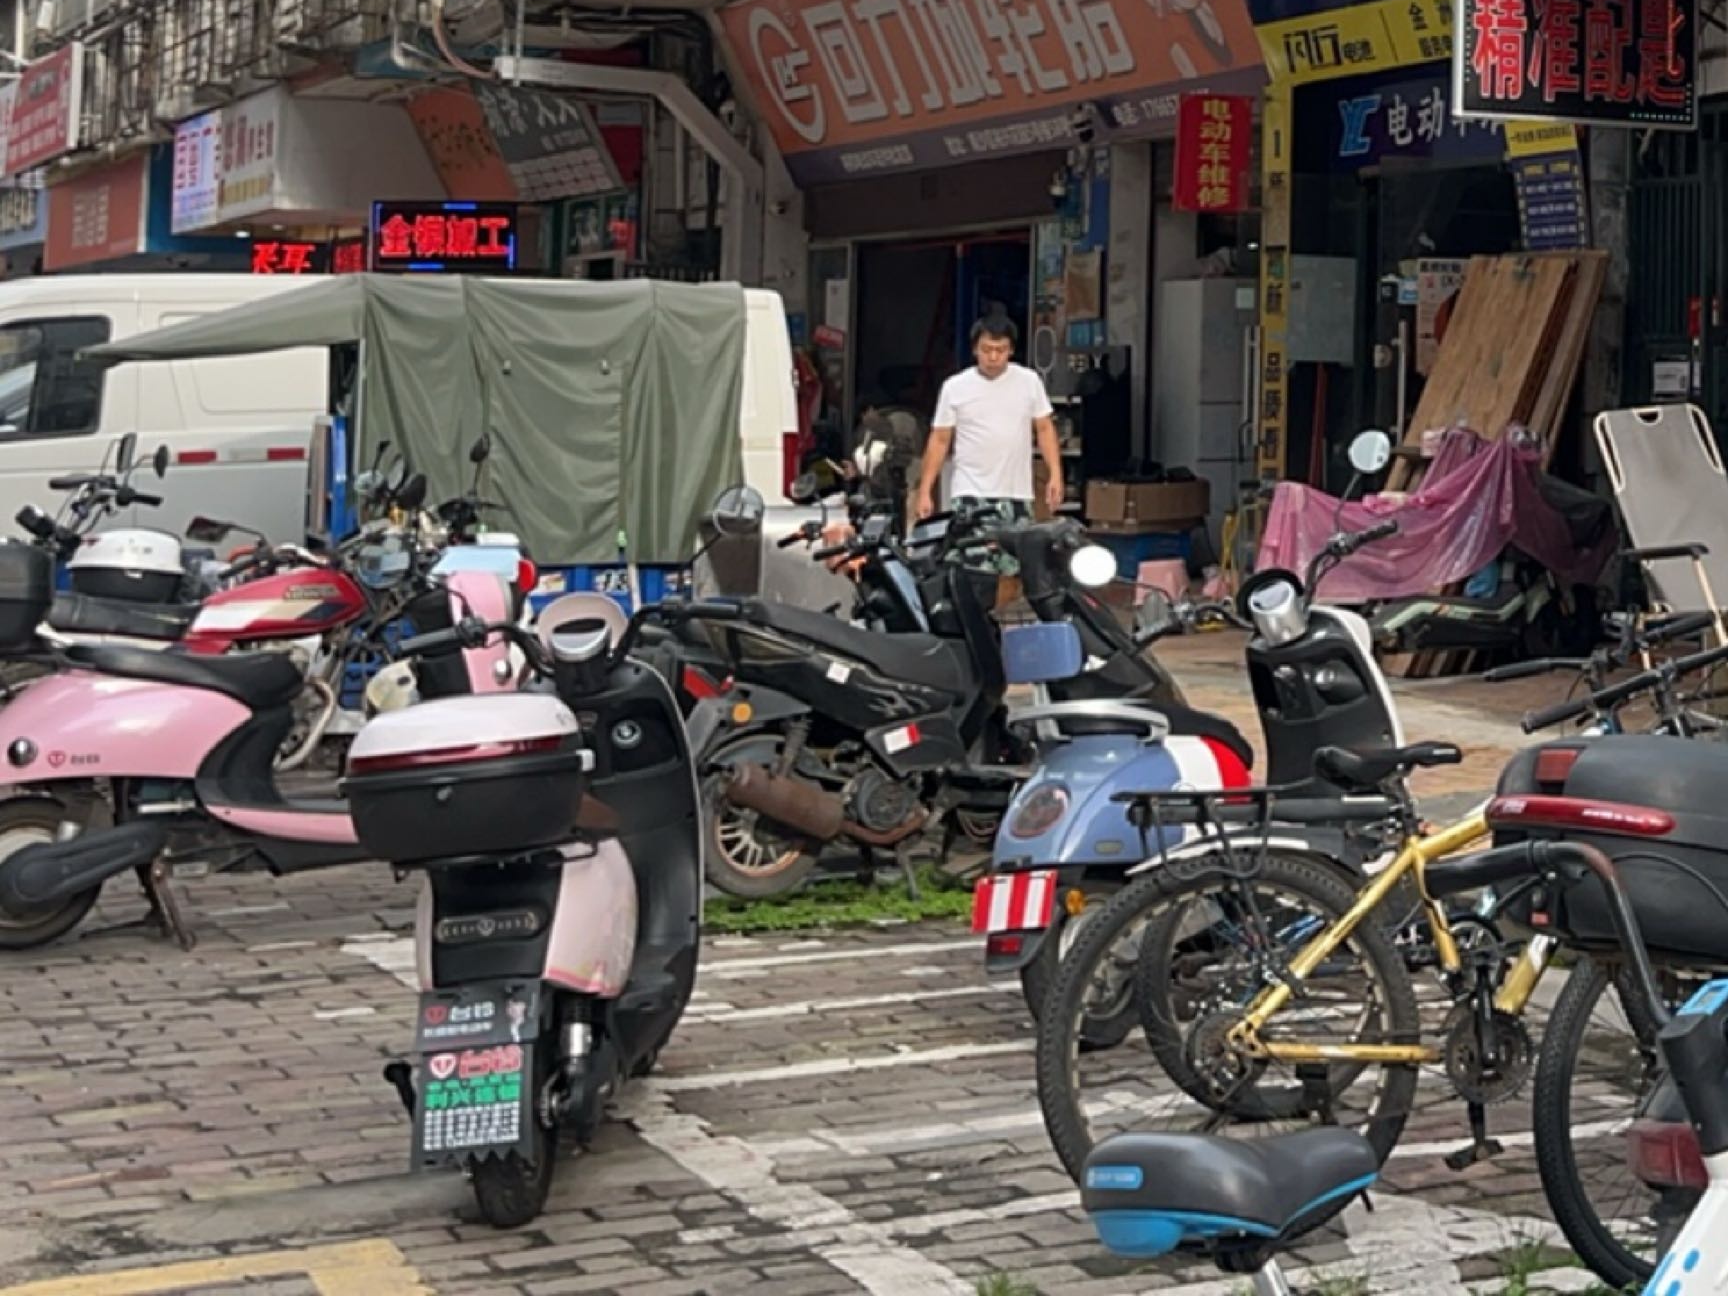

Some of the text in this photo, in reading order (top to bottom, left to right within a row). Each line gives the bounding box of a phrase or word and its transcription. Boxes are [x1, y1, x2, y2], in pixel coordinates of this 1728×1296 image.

[1197, 98, 1233, 208] 电动车维修
